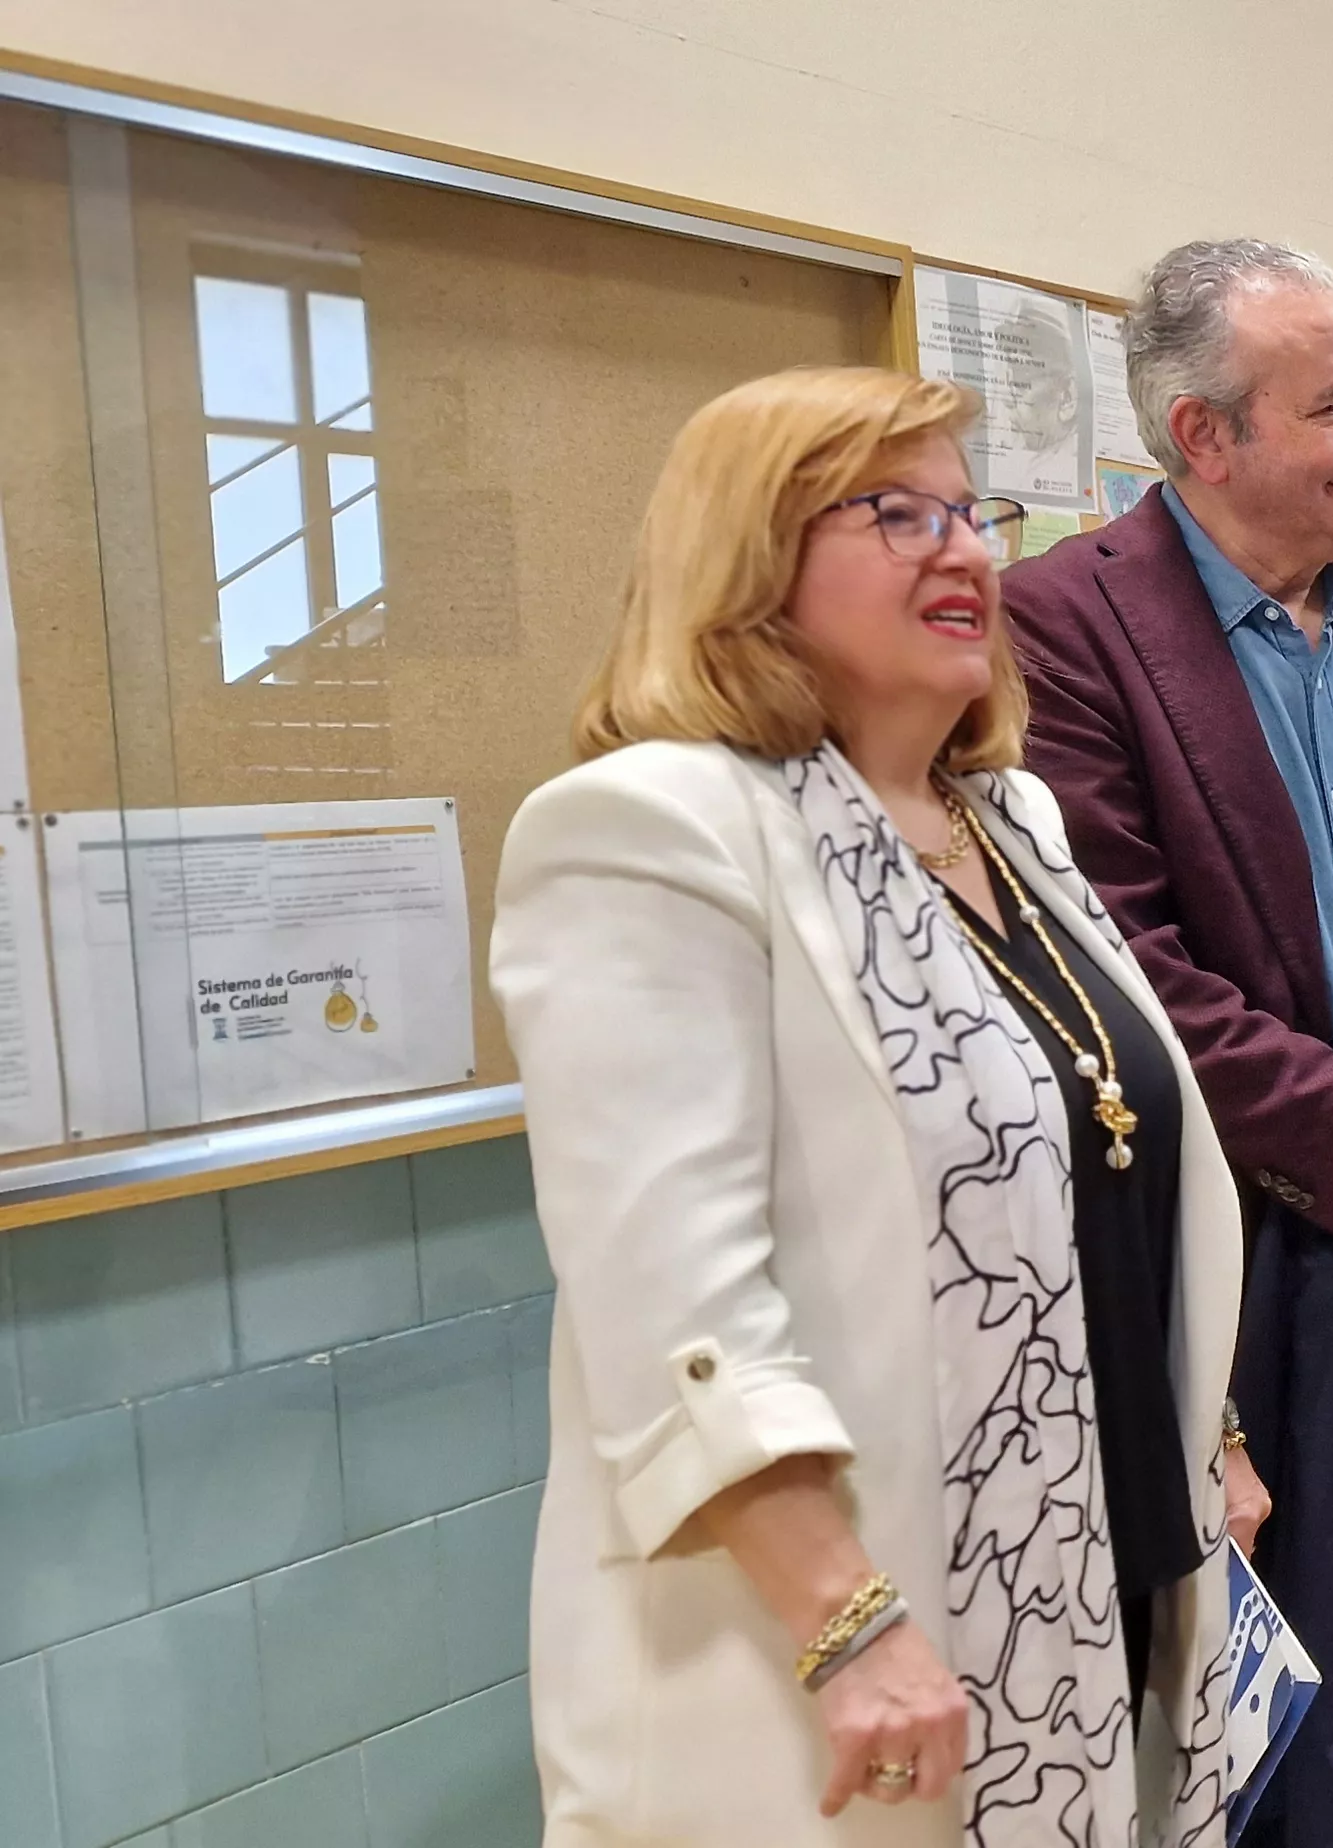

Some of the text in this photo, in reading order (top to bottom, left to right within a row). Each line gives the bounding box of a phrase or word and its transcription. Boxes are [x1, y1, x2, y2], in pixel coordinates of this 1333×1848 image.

[198, 964, 354, 996] Sistema de Garantía
[200, 990, 288, 1014] de Calidad
